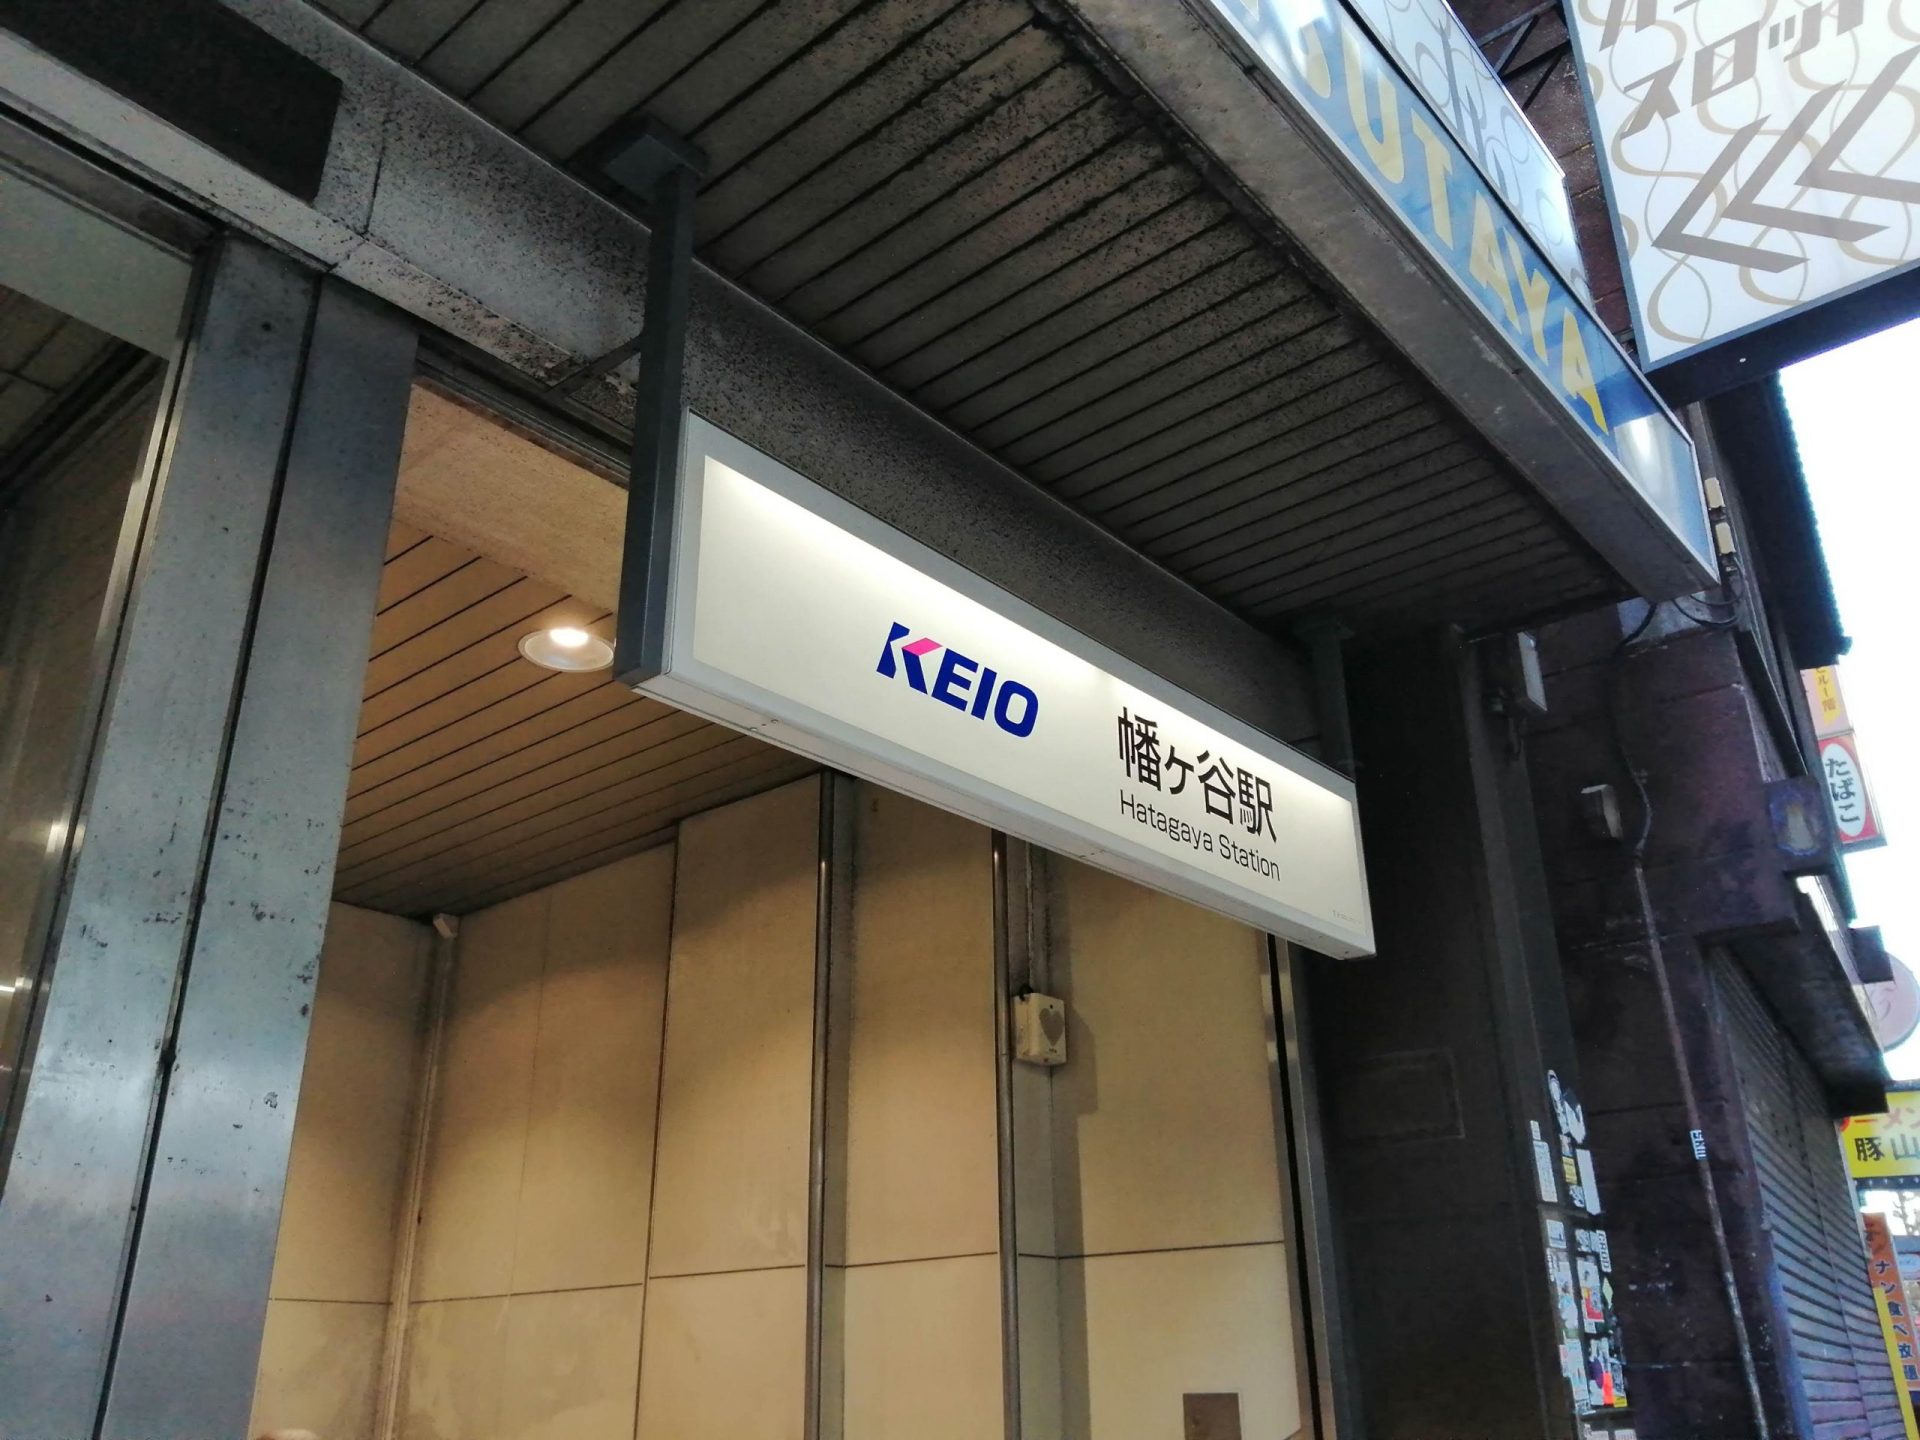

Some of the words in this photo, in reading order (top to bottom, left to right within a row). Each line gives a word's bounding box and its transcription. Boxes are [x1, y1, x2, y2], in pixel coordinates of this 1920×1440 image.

[876, 621, 1039, 738] KEIO
[1120, 789, 1214, 853] Hatagaya
[1218, 833, 1281, 882] Station
[1824, 757, 1861, 823] たばこ
